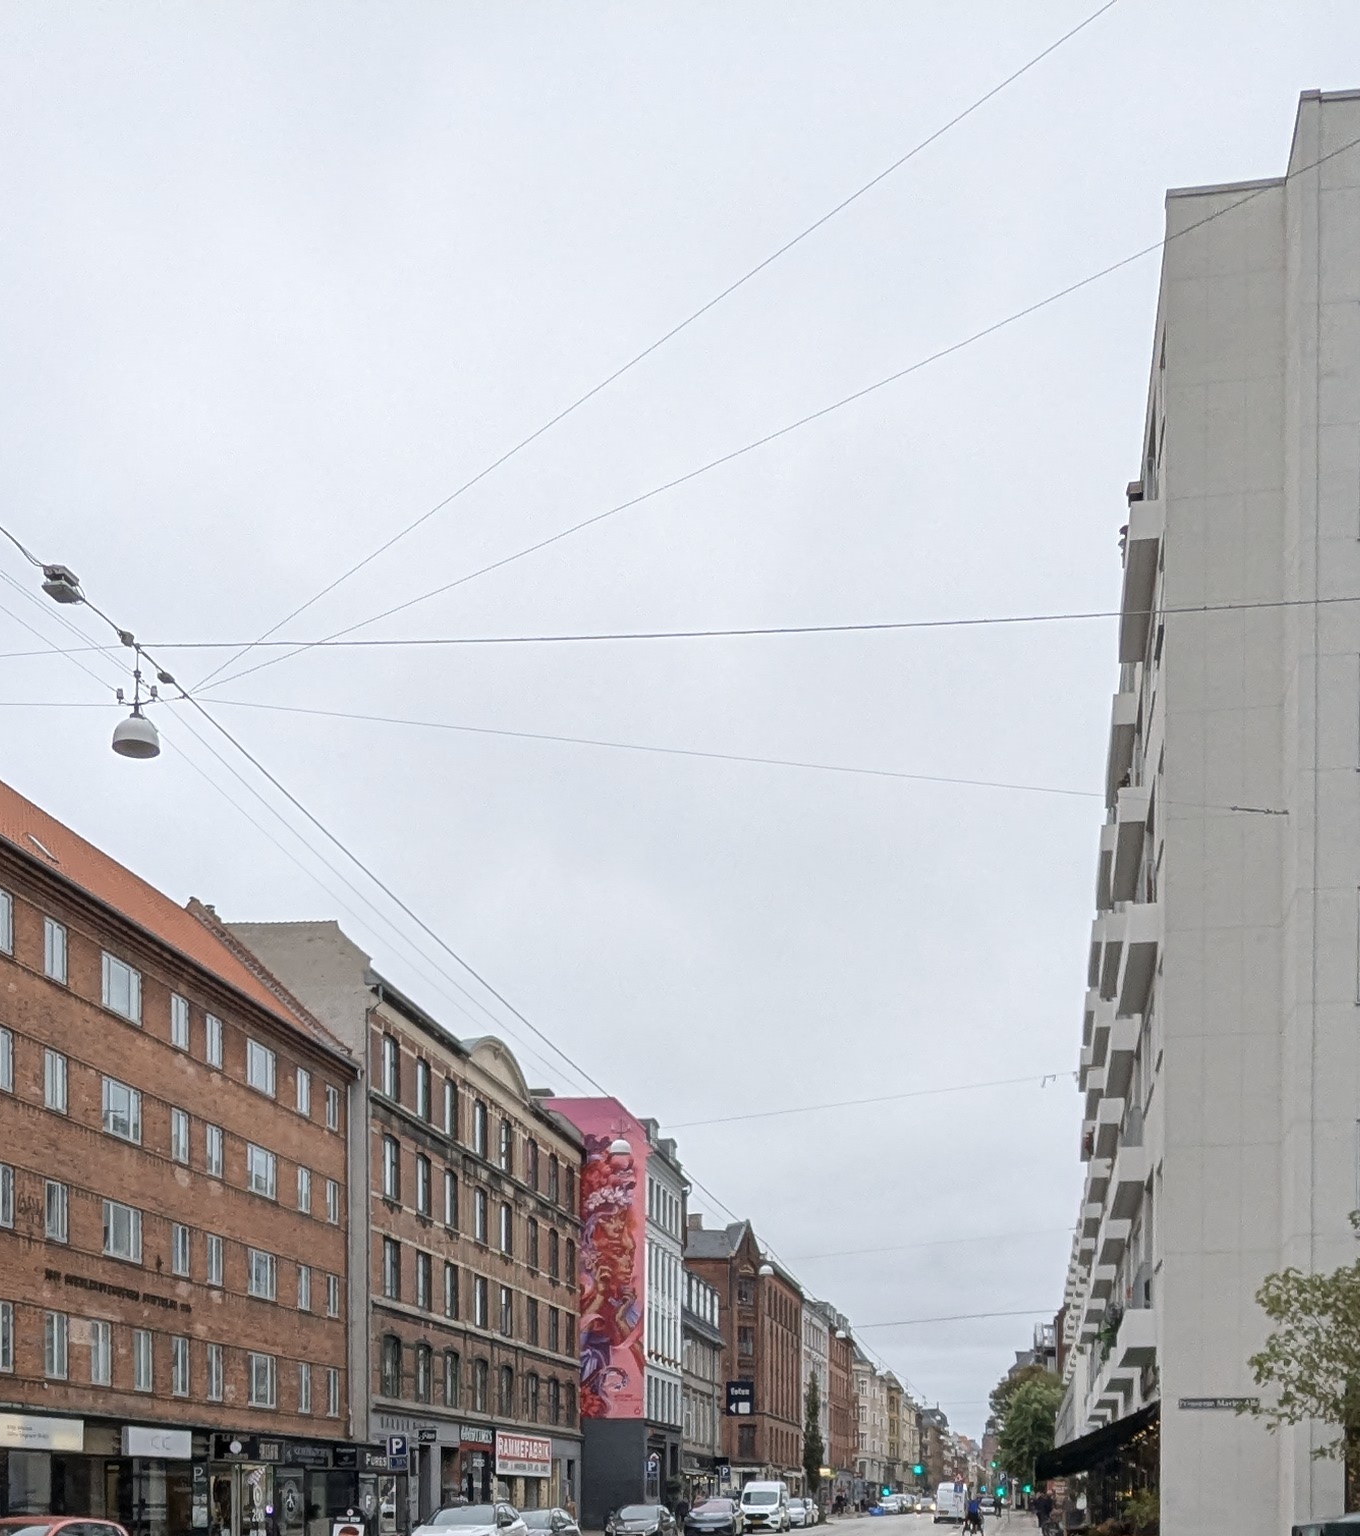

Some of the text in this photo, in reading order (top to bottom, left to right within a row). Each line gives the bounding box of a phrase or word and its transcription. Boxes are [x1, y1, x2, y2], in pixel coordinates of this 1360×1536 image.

[392, 1438, 403, 1455] P
[193, 1466, 204, 1482] P
[647, 1461, 656, 1472] P
